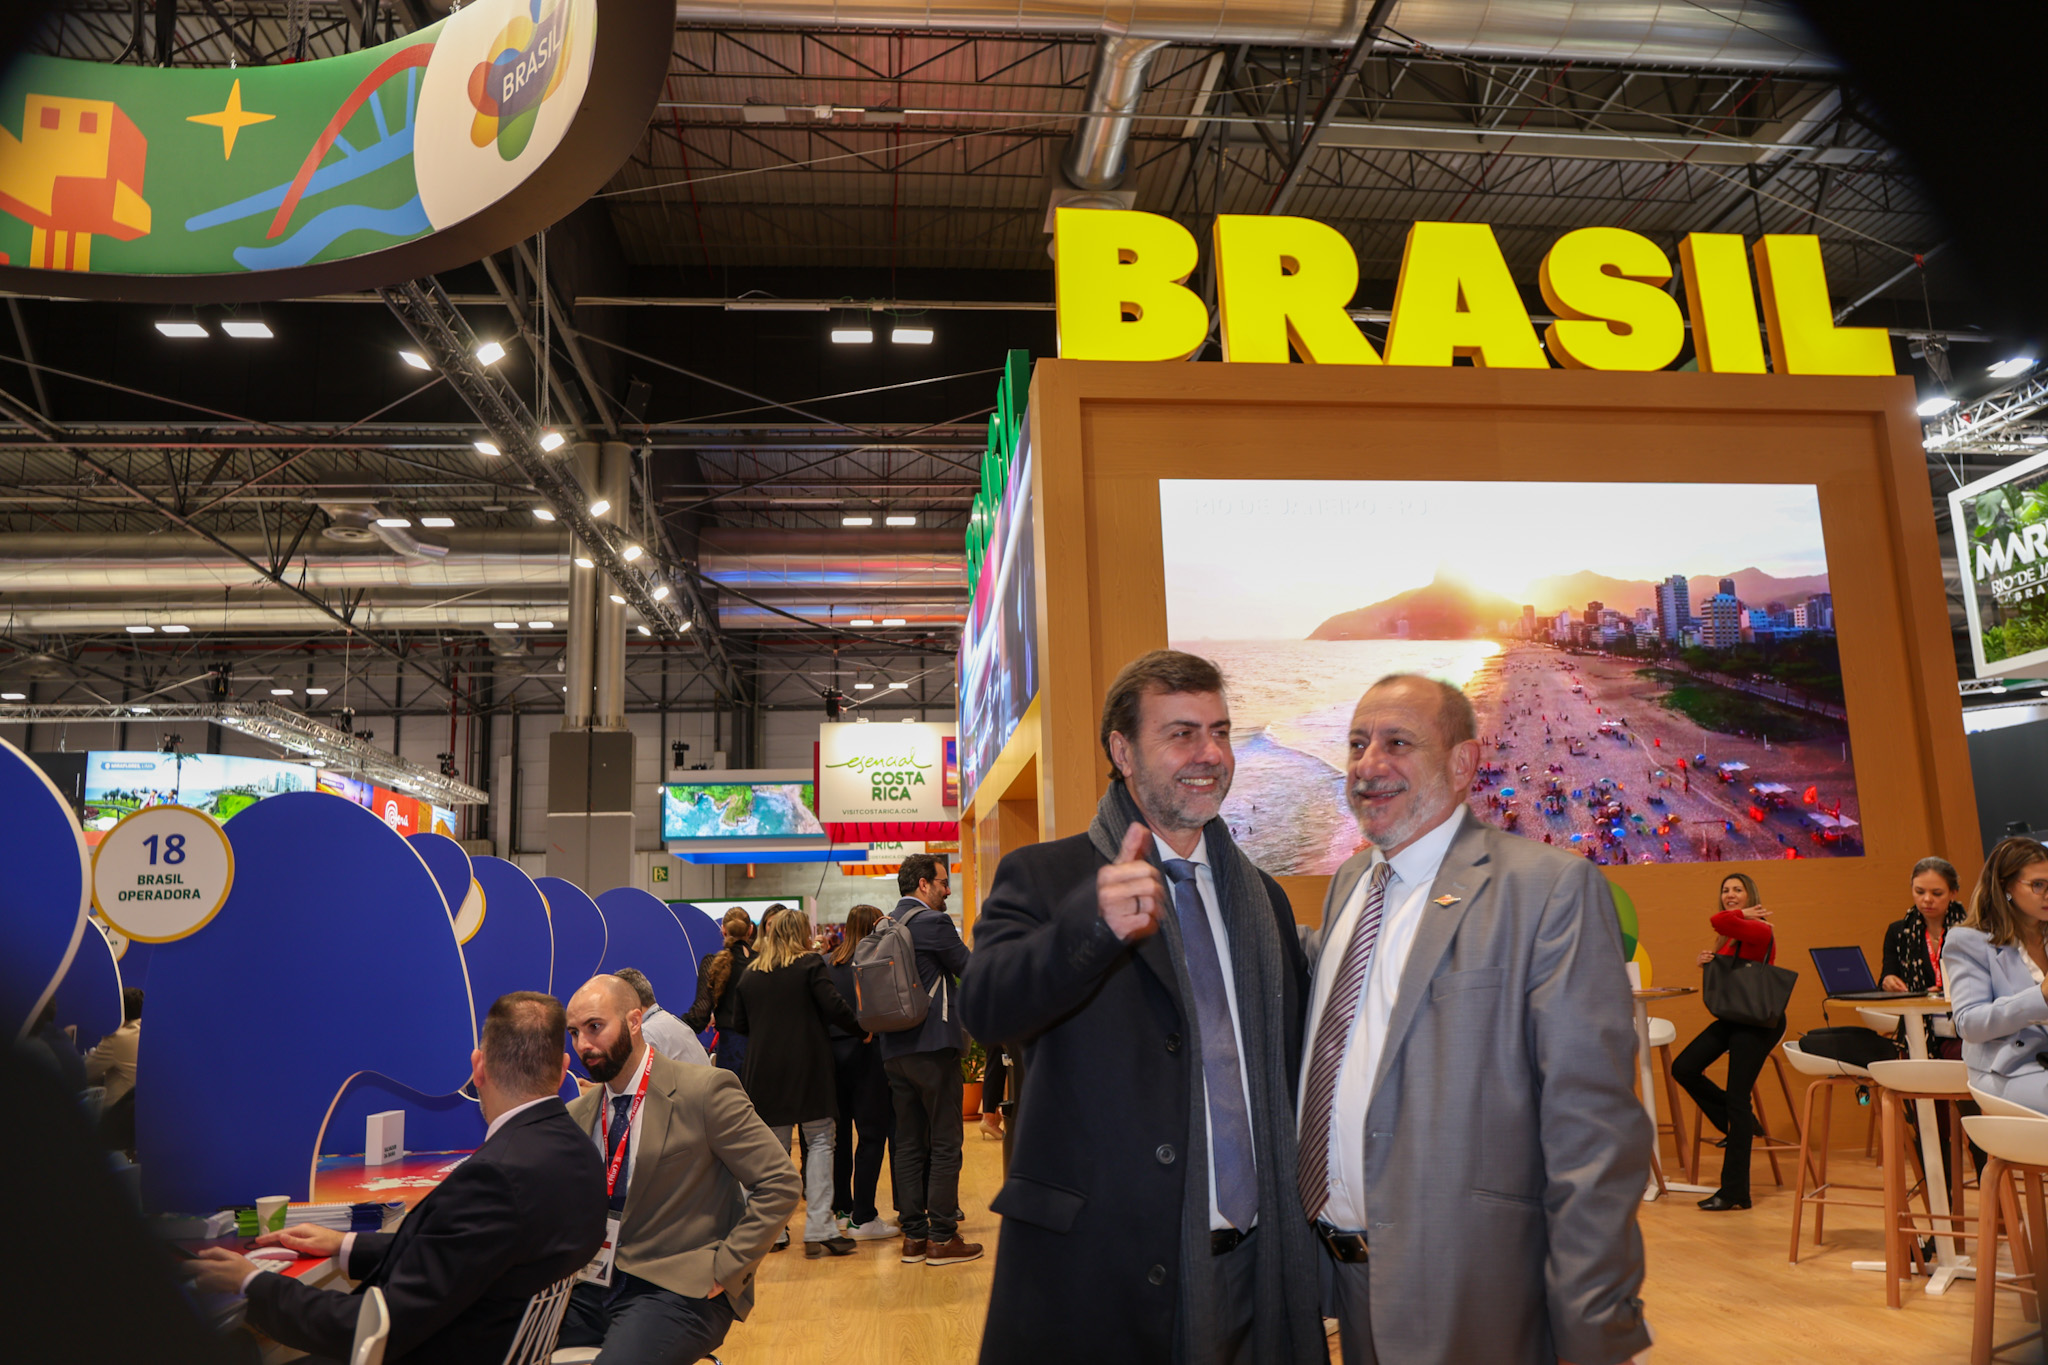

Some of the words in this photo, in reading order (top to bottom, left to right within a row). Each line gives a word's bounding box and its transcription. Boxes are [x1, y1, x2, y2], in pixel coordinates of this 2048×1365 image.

[502, 24, 561, 104] BRASIL
[1054, 207, 1895, 376] BRASIL
[1976, 519, 2048, 581] MAR
[1991, 575, 2014, 595] RIO
[2016, 567, 2037, 586] DE
[2014, 584, 2048, 602] BRA
[826, 746, 932, 774] esencial
[871, 771, 926, 786] COSTA
[871, 786, 912, 801] RICA
[842, 808, 918, 816] VISITCOSTARICA.COM
[142, 833, 187, 866] 18
[137, 873, 184, 886] BRASIL
[118, 888, 201, 902] OPERADORA
